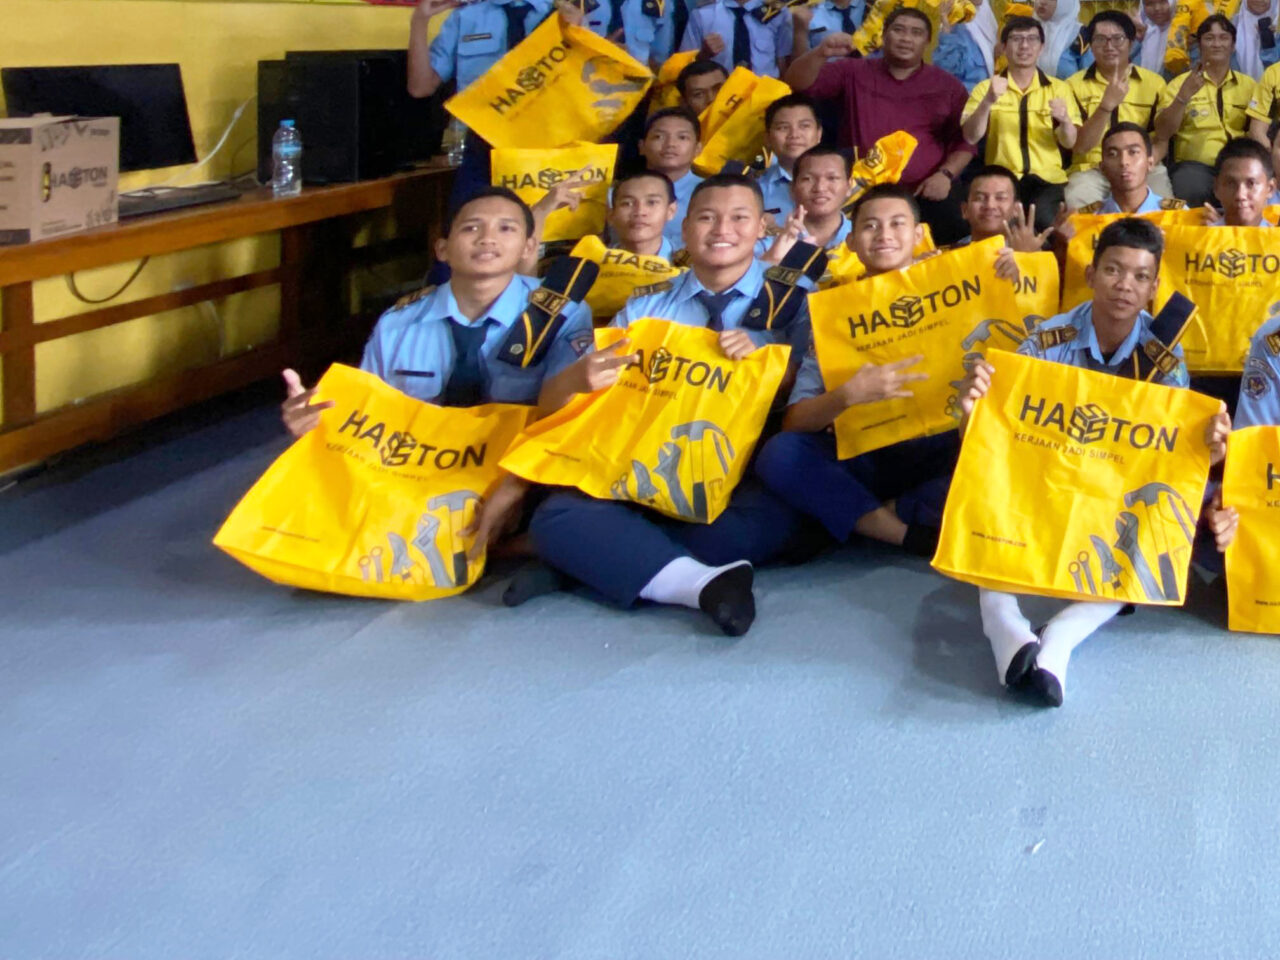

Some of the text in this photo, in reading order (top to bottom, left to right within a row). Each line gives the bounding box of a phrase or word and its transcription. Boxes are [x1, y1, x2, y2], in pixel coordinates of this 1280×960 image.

[1013, 431, 1127, 466] KERJAAN JADI SIMPEL
